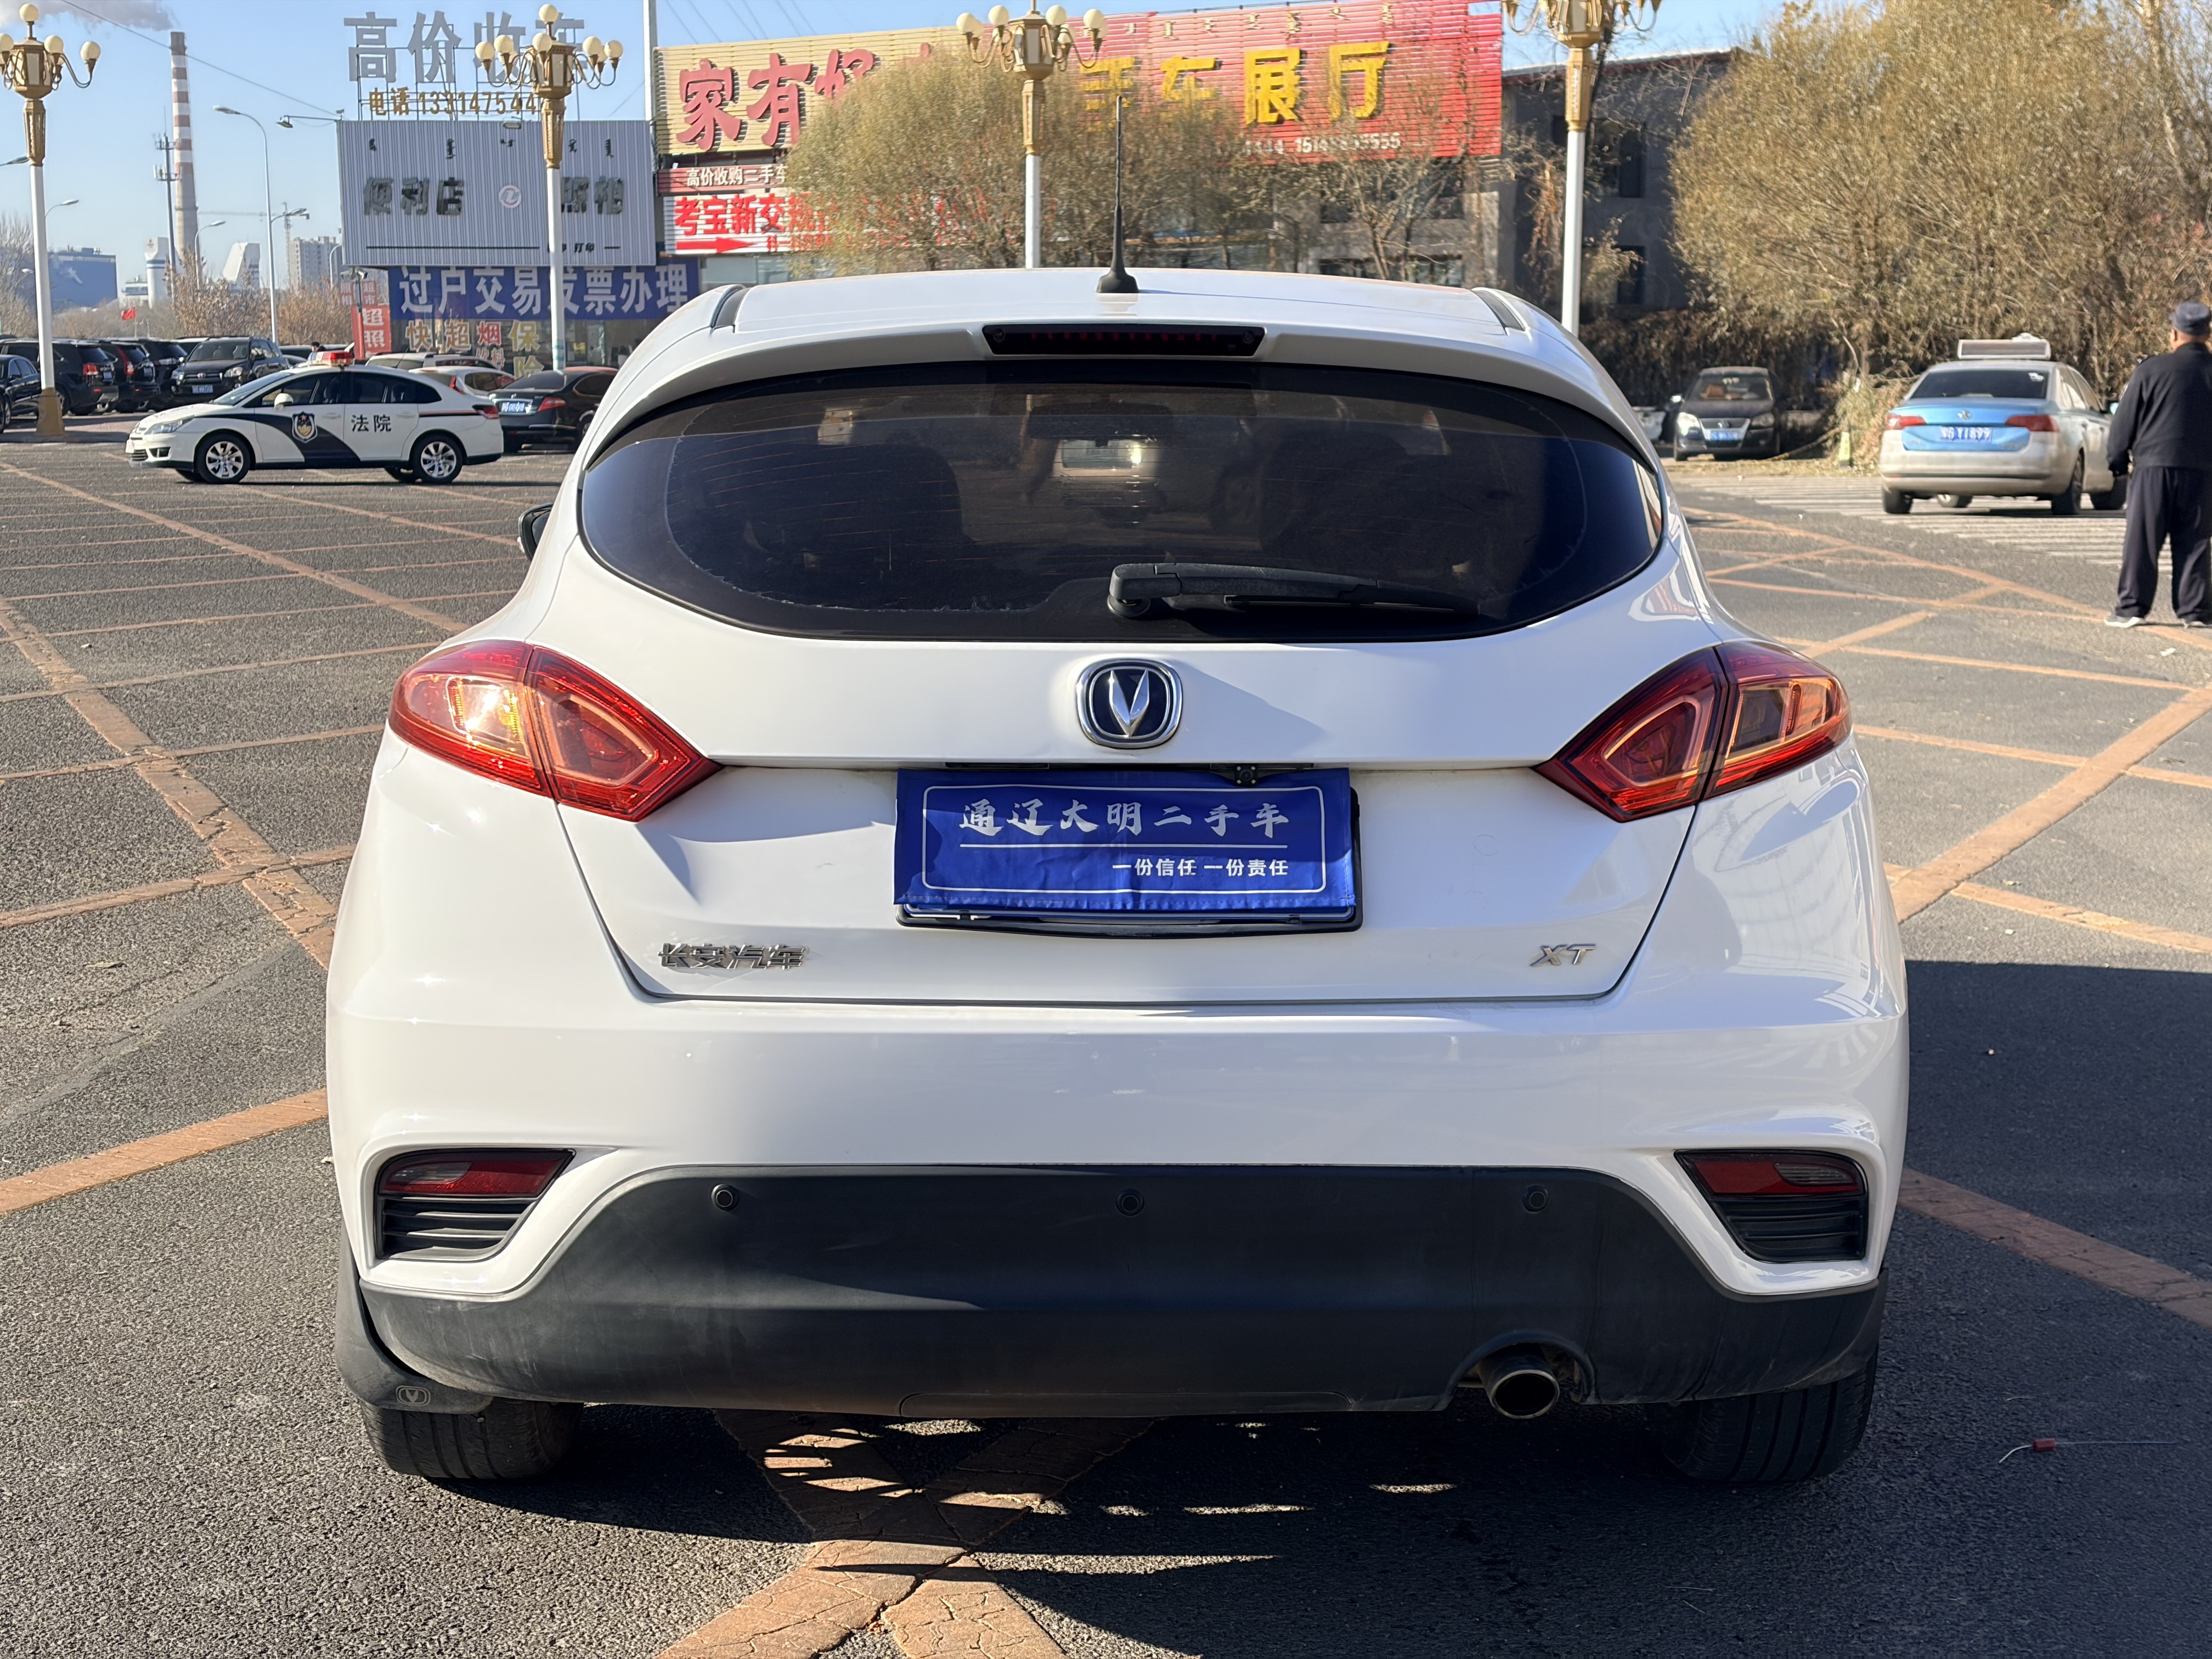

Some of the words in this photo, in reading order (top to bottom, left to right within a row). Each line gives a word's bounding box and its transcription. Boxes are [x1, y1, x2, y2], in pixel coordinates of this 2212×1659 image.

[369, 87, 410, 116] 电话
[351, 414, 392, 433] 法院
[959, 798, 1289, 837] 通辽大明二手车
[1111, 857, 1197, 877] 一份信任
[1204, 858, 1289, 877] 一份责任
[658, 942, 807, 970] 长安汽车
[1530, 943, 1596, 967] XT
